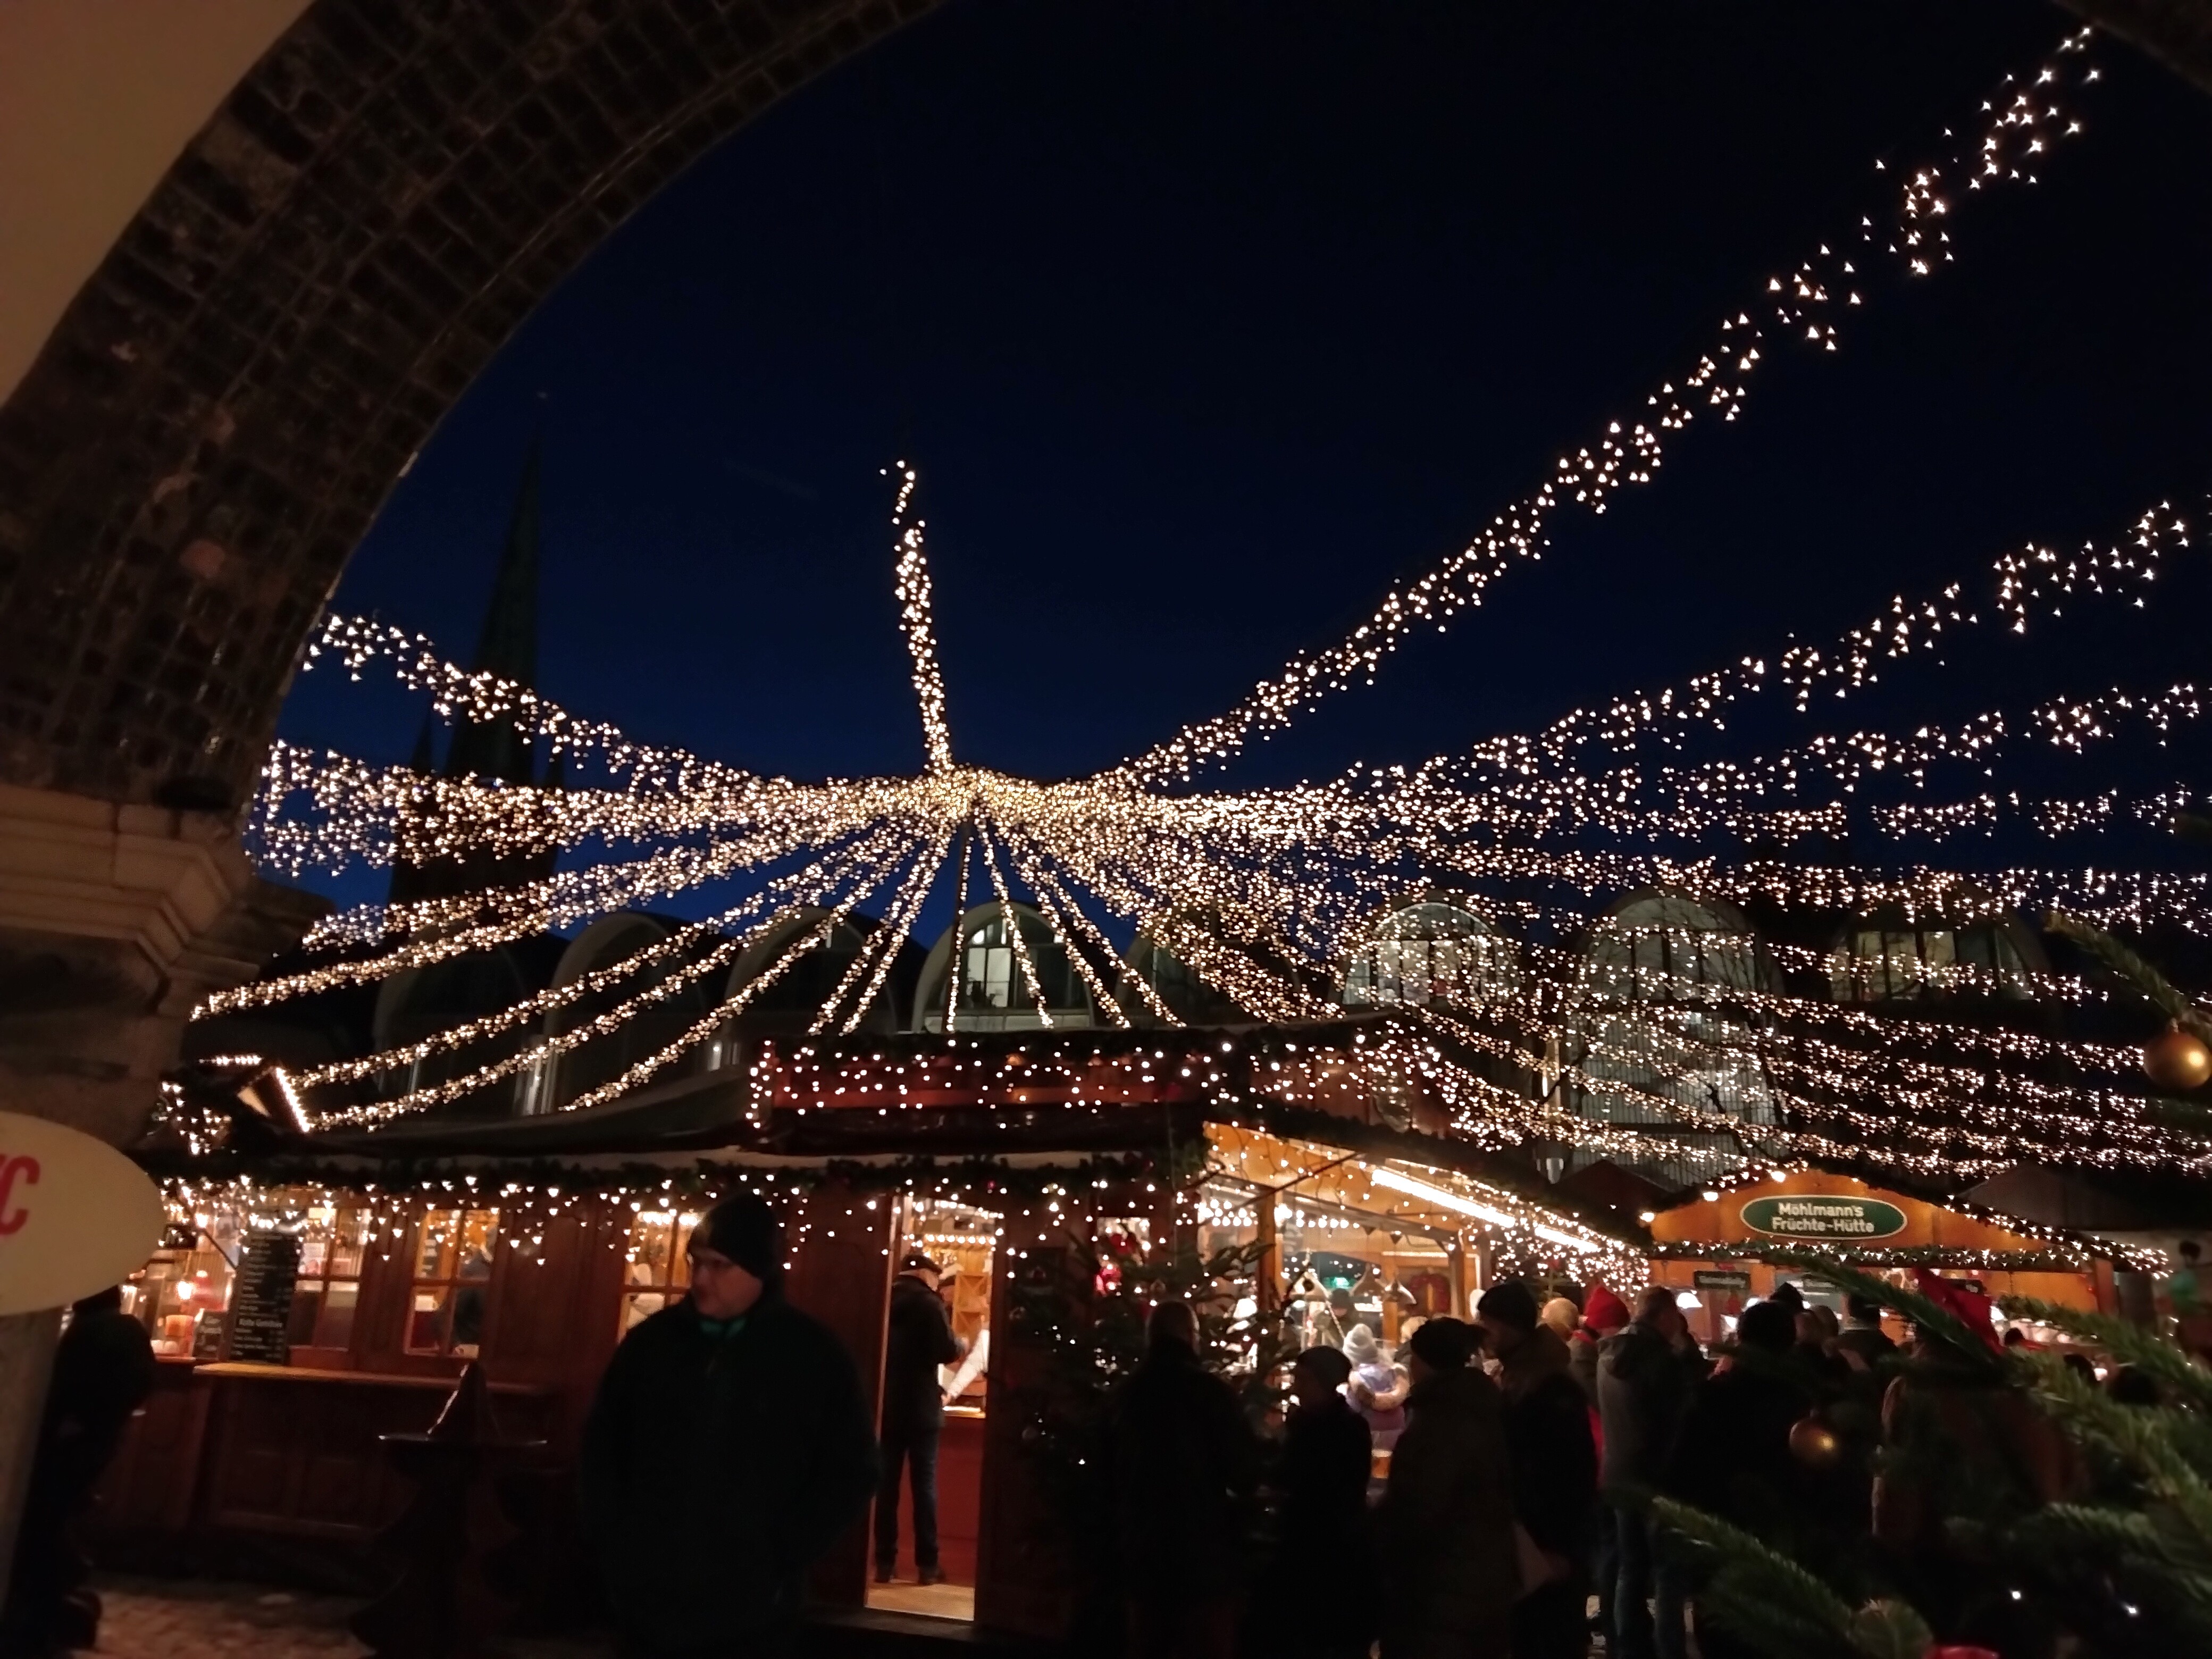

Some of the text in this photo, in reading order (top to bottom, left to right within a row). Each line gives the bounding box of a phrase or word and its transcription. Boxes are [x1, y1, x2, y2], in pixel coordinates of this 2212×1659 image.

[0, 1154, 40, 1235] C
[1778, 1202, 1864, 1217] Möhlmann's
[1772, 1216, 1875, 1233] Früchte-Hütte
